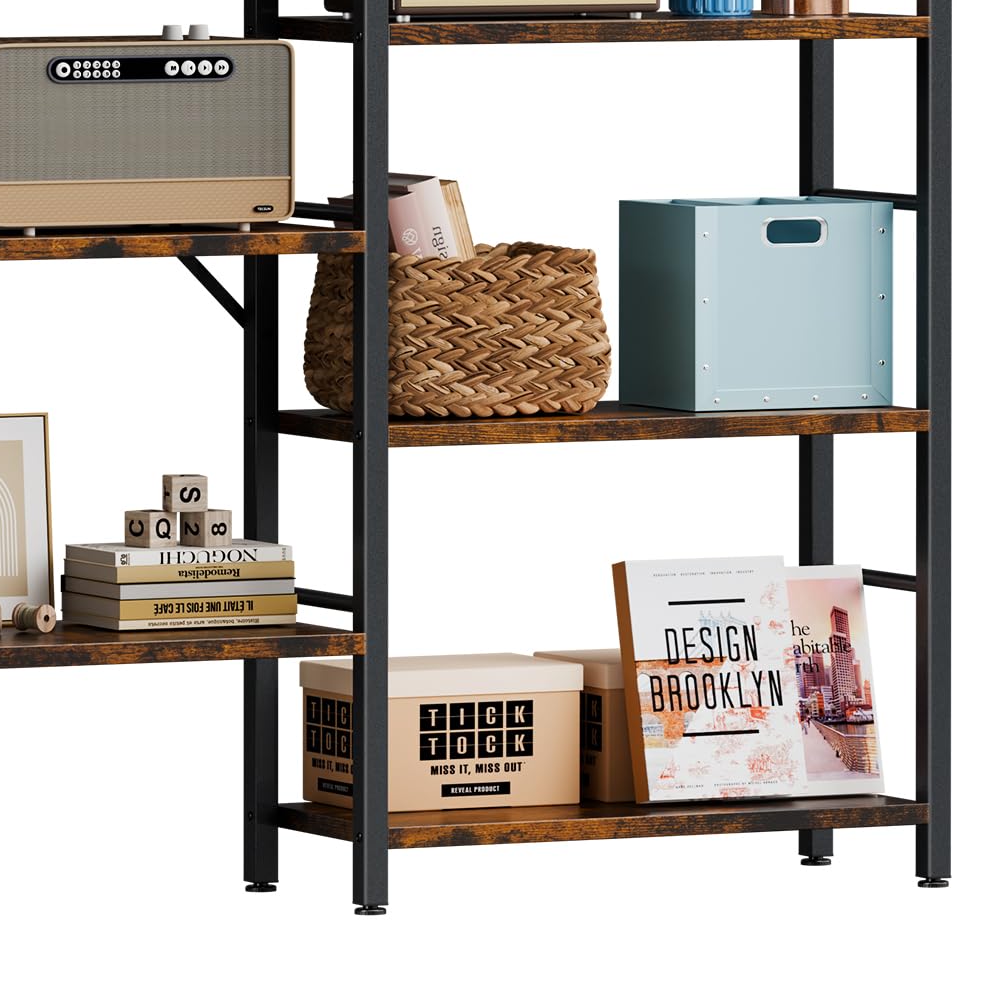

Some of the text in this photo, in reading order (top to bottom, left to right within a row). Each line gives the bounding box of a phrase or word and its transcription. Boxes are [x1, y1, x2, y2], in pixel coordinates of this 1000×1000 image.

[180, 486, 201, 503] S
[155, 518, 171, 539] Q
[185, 521, 200, 536] 2
[211, 522, 227, 536] 8
[160, 548, 257, 564] NOGUCHI
[178, 568, 240, 579] Remodelista
[154, 600, 254, 616] IL ÉTAIT UNE FOIS LE CAFÉ
[790, 620, 810, 636] he
[665, 624, 758, 665] DESIGN
[793, 638, 852, 655] abitable
[796, 656, 819, 673] rth
[650, 670, 784, 712] BROOKLYN
[428, 706, 525, 726] TICK
[428, 734, 525, 755] TOCK
[430, 762, 522, 775] MISS IT, MISS OUT
[451, 785, 500, 794] REVEAL PRODUCT
